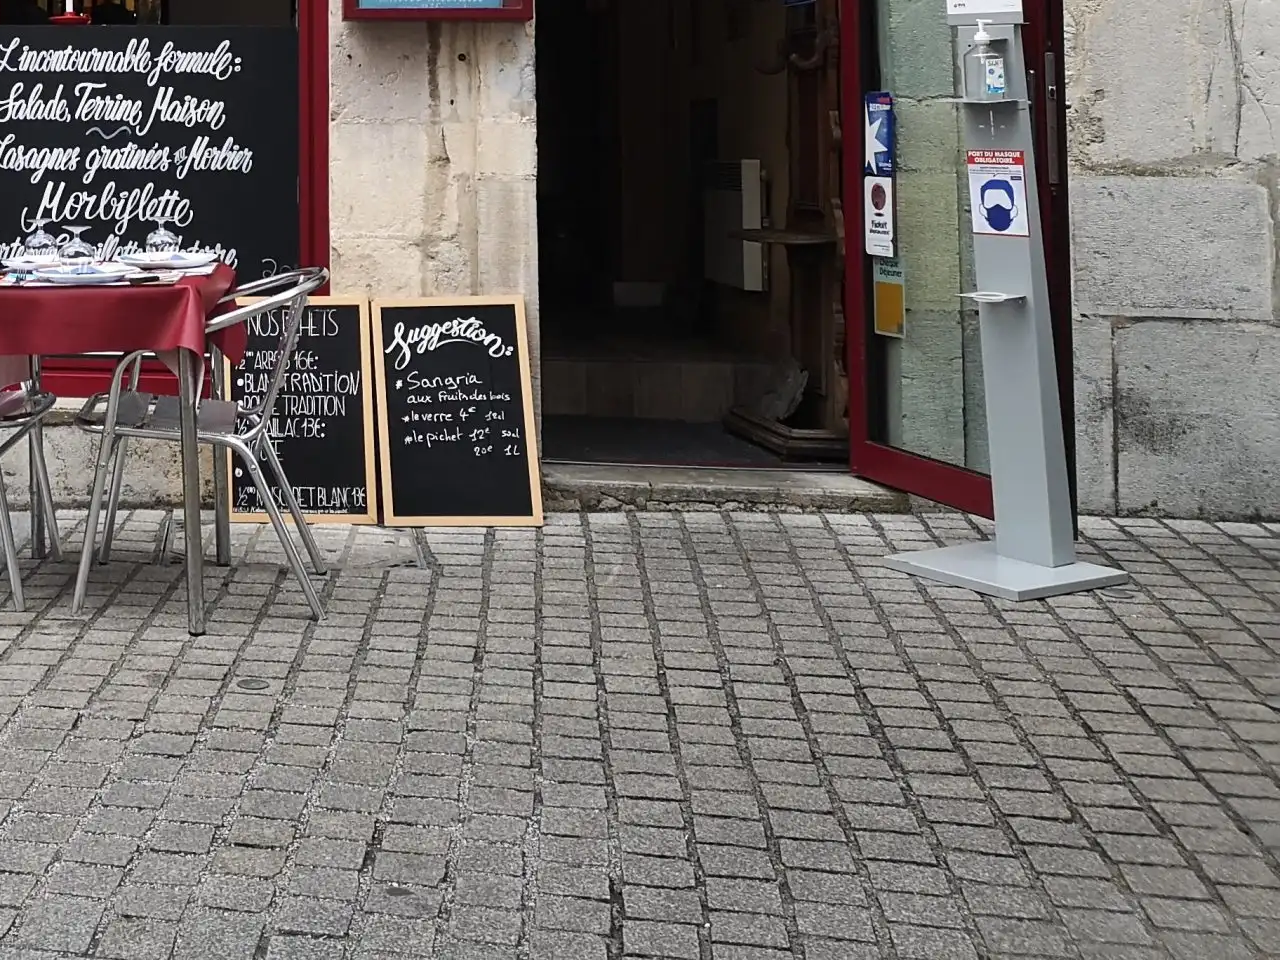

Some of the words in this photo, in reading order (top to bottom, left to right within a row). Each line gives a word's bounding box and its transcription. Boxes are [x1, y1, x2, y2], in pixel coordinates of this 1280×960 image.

[147, 40, 241, 86] formule:
[74, 82, 142, 126] Terrine
[136, 86, 225, 136] Maison
[82, 142, 171, 184] gratinées
[176, 136, 253, 179] Morbier
[21, 181, 193, 235] Morbiflette
[247, 310, 280, 336] NOS
[384, 316, 514, 370] Suggestion:
[406, 370, 483, 390] Sangria
[281, 394, 346, 417] TRADITION
[406, 395, 433, 404] aux
[468, 389, 487, 401] des
[489, 390, 511, 401] bois
[411, 410, 420, 422] le
[421, 413, 454, 422] verre
[265, 417, 300, 438] AILLAC
[412, 430, 424, 443] le
[426, 426, 463, 448] pichet
[504, 444, 520, 456] 1L
[317, 487, 351, 508] BLANC
